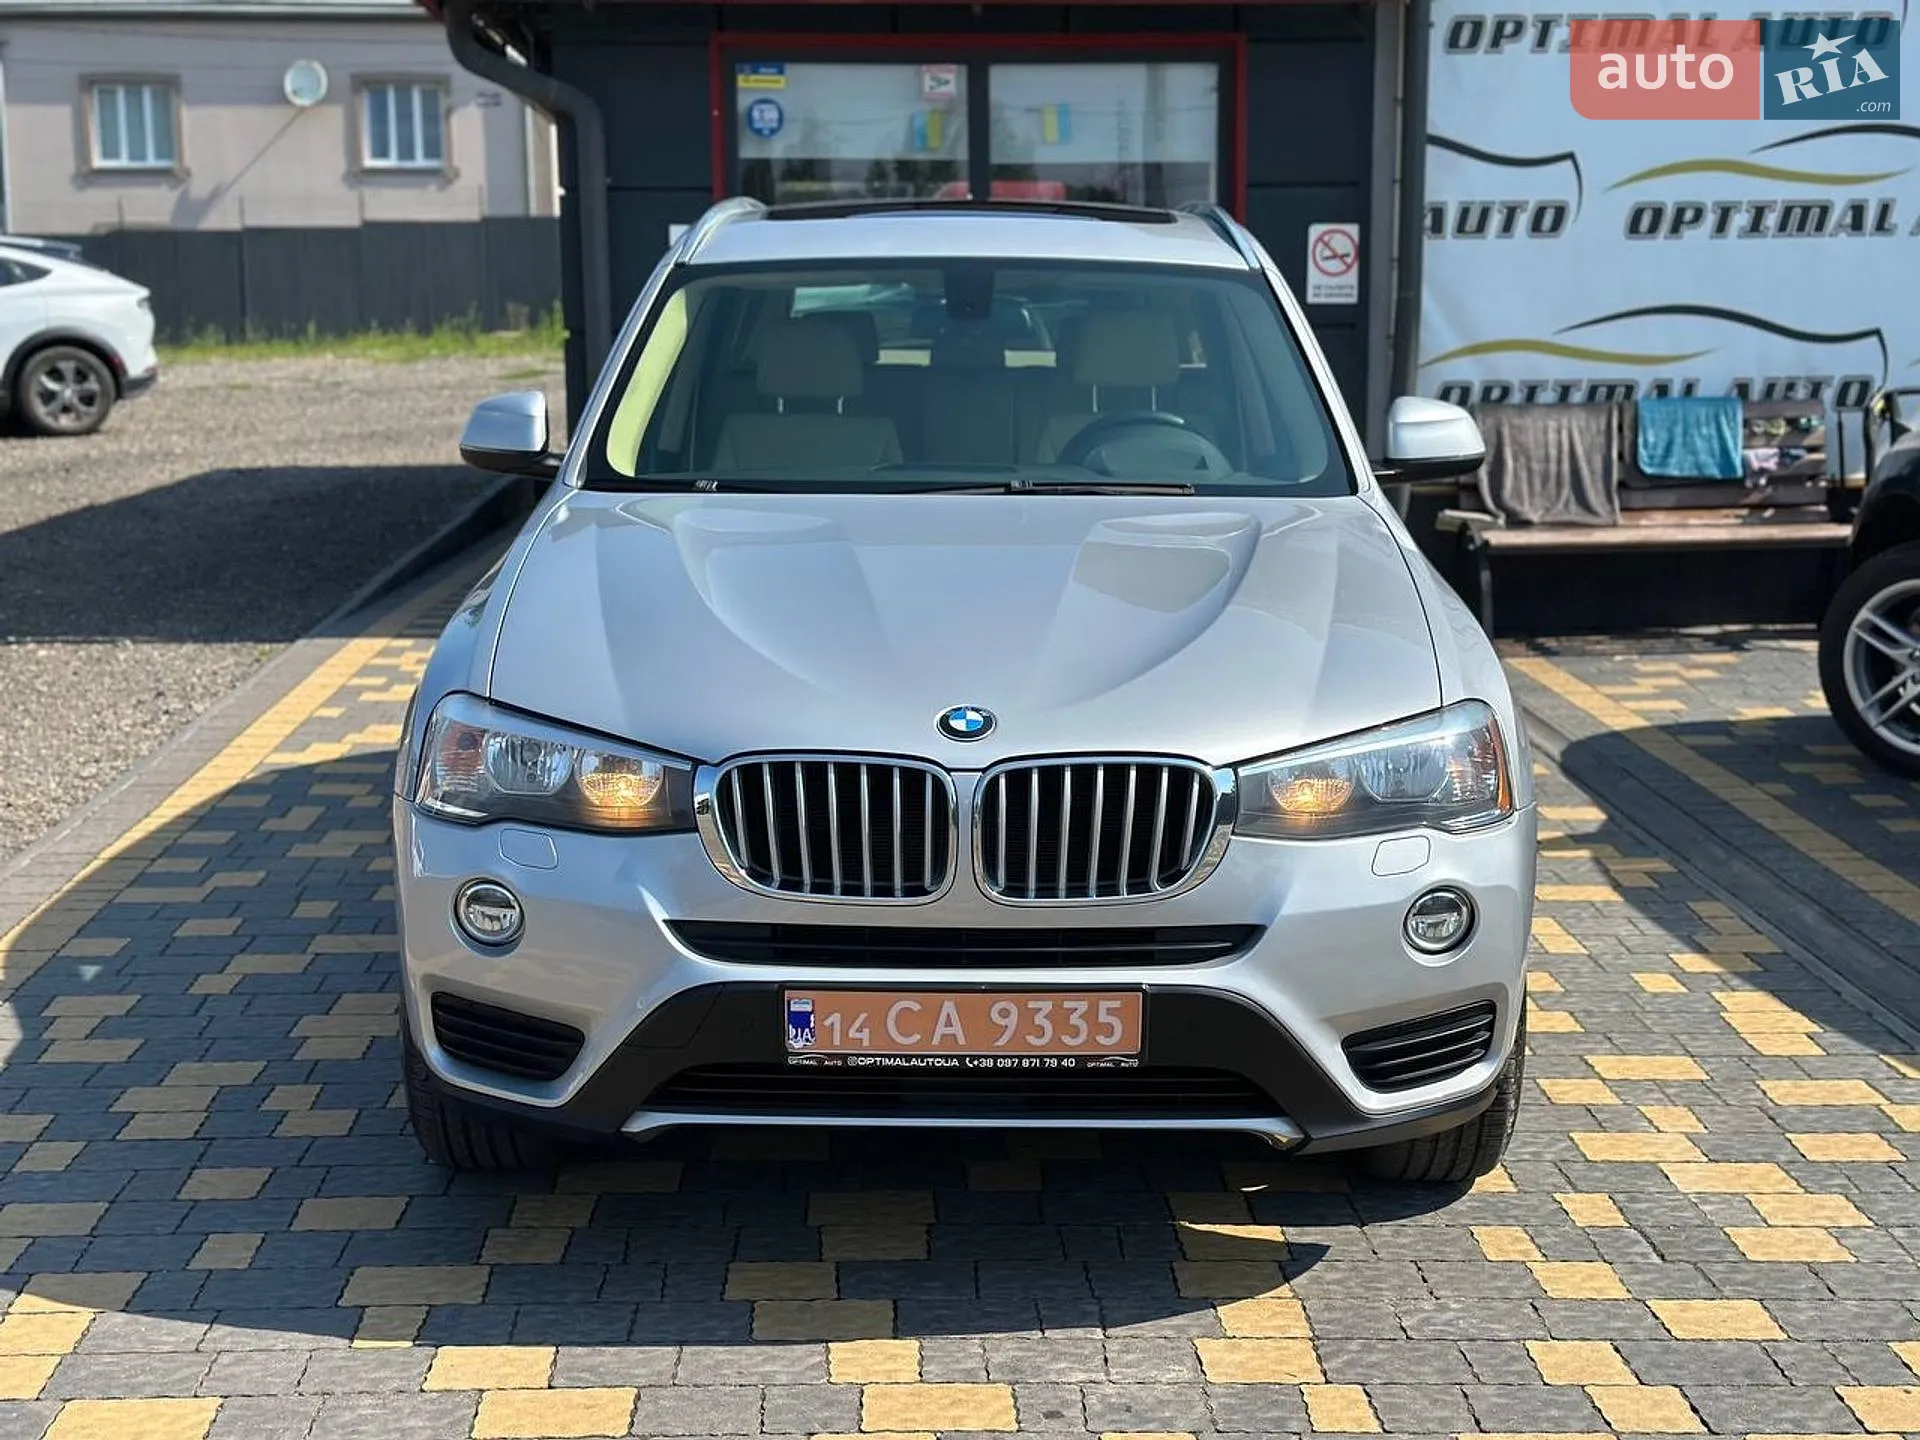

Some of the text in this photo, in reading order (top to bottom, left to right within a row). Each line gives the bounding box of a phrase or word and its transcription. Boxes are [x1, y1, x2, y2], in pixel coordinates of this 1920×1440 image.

[1443, 12, 1894, 54] OPTIMAL AUTO
[1424, 200, 1571, 240] AUTO
[1622, 198, 1898, 239] OPTIMAL
[989, 1001, 1124, 1047] 9335
